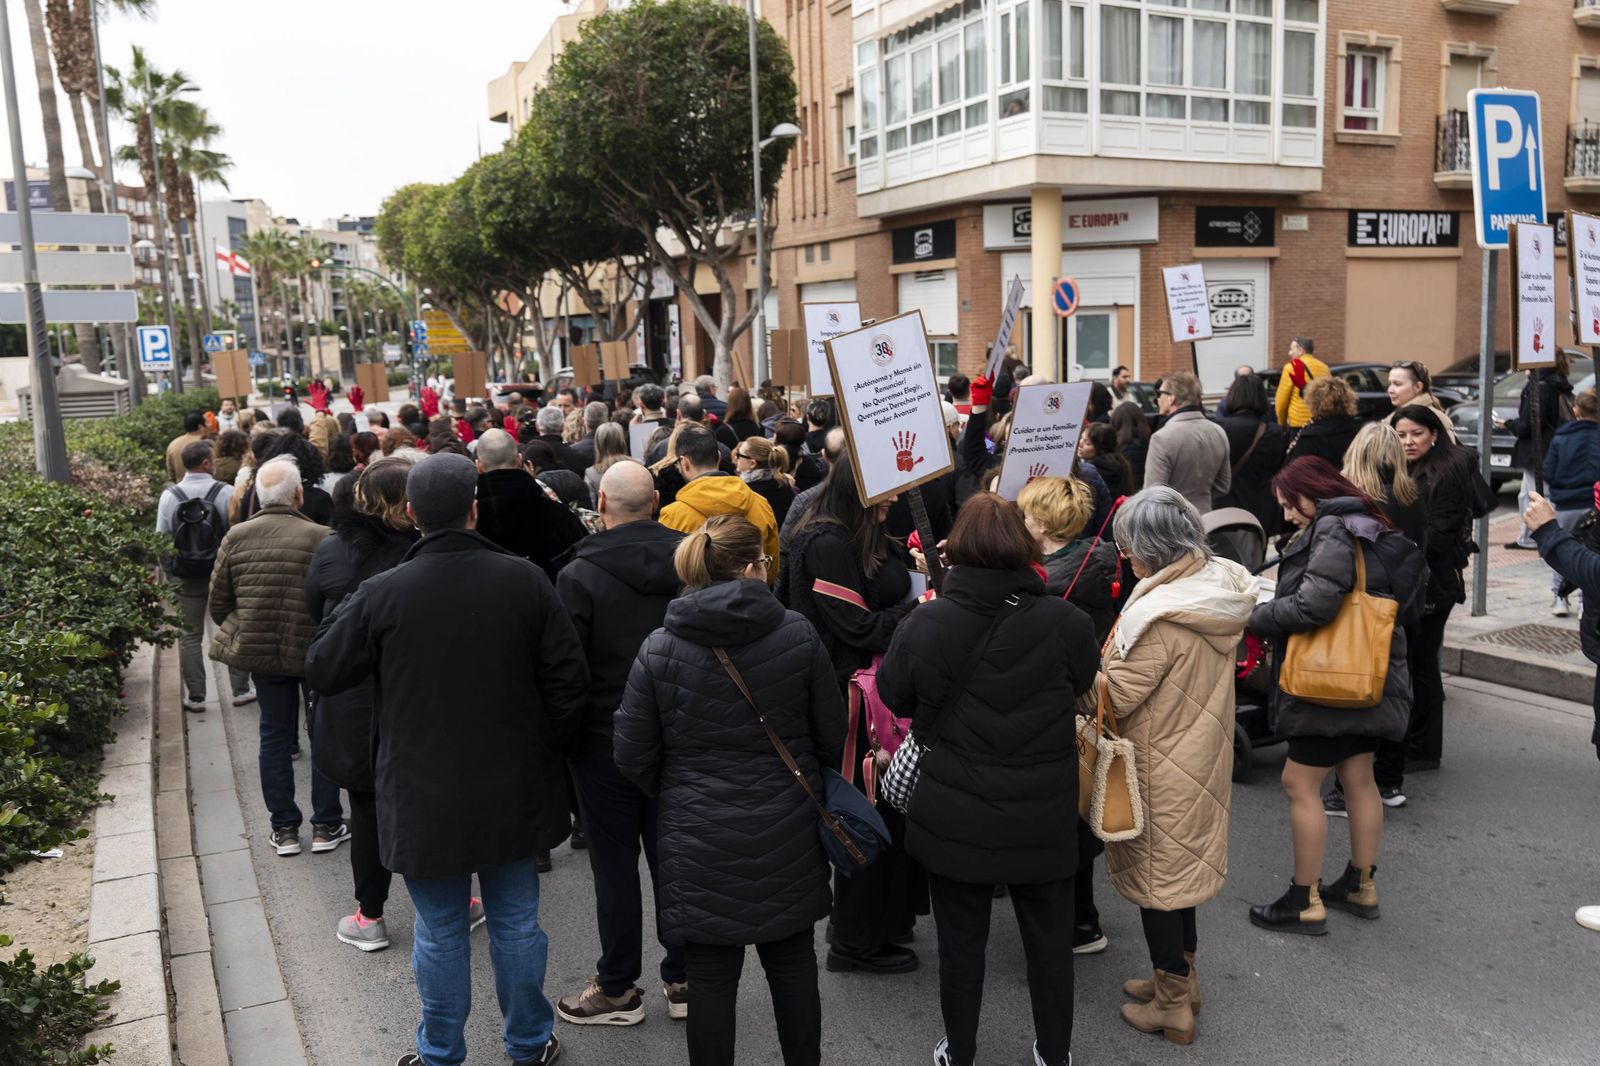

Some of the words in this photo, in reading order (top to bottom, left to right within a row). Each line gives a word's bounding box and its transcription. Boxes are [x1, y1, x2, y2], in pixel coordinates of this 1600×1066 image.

[1484, 104, 1522, 190] P
[1378, 212, 1437, 244] EUROPA
[143, 330, 166, 360] P
[893, 366, 912, 376] Mamá
[857, 407, 888, 423] Queremos
[889, 396, 916, 410] Derechos
[917, 391, 931, 402] para
[872, 392, 904, 406] Queremos
[874, 416, 892, 426] Poder
[893, 406, 919, 420] Avanzar
[1013, 426, 1035, 435] Cuidar
[1052, 422, 1078, 431] Familiar
[1045, 442, 1064, 451] Social
